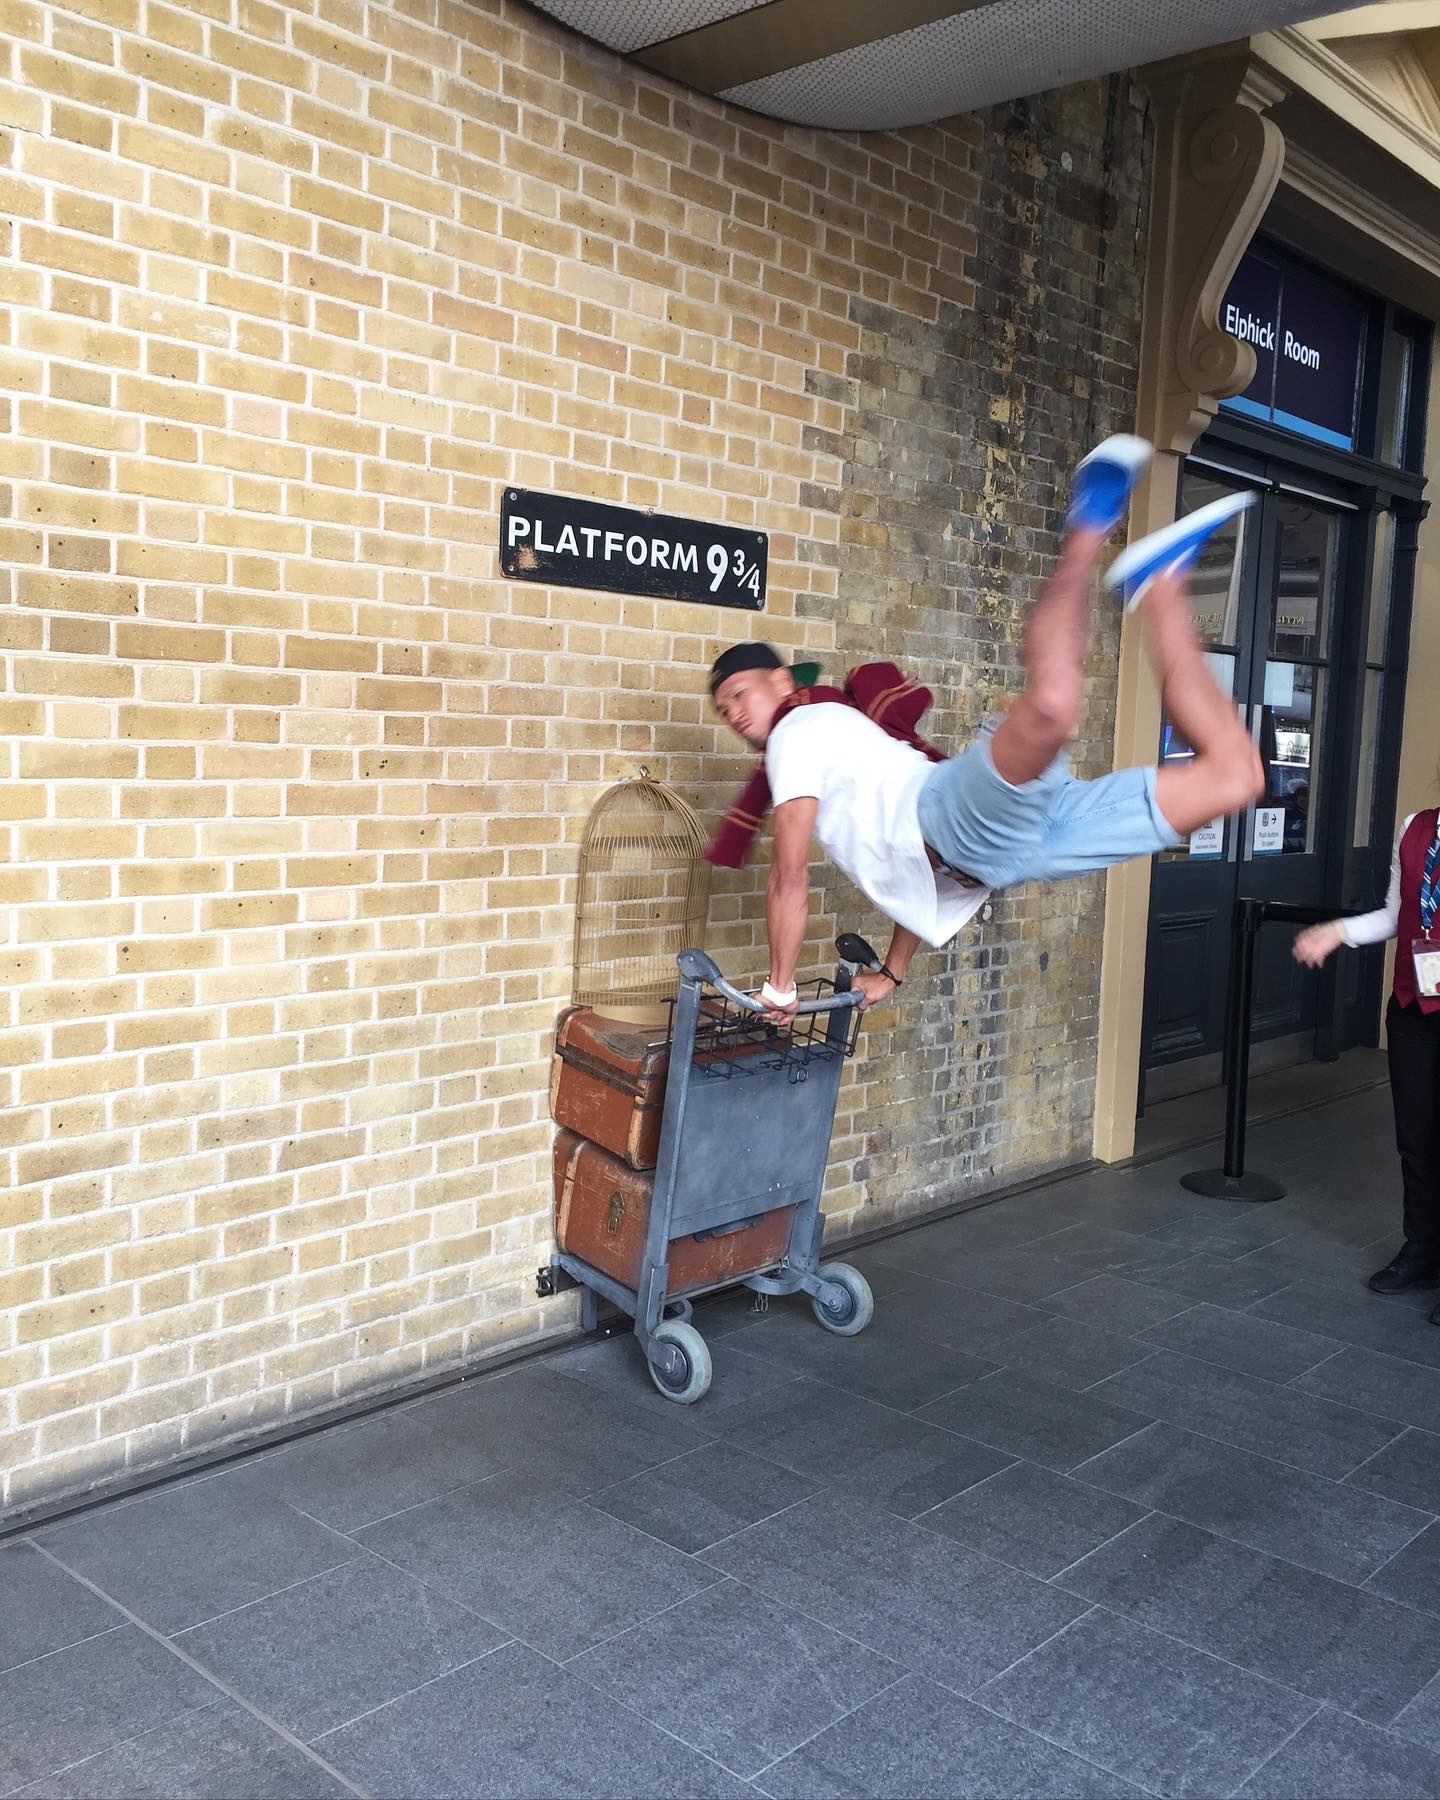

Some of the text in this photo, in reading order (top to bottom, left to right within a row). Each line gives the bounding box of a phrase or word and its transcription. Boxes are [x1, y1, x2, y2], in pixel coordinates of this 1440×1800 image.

[1225, 303, 1320, 370] Elphick Room
[508, 515, 699, 574] PLATFORM
[1198, 832, 1216, 841] CAUTION
